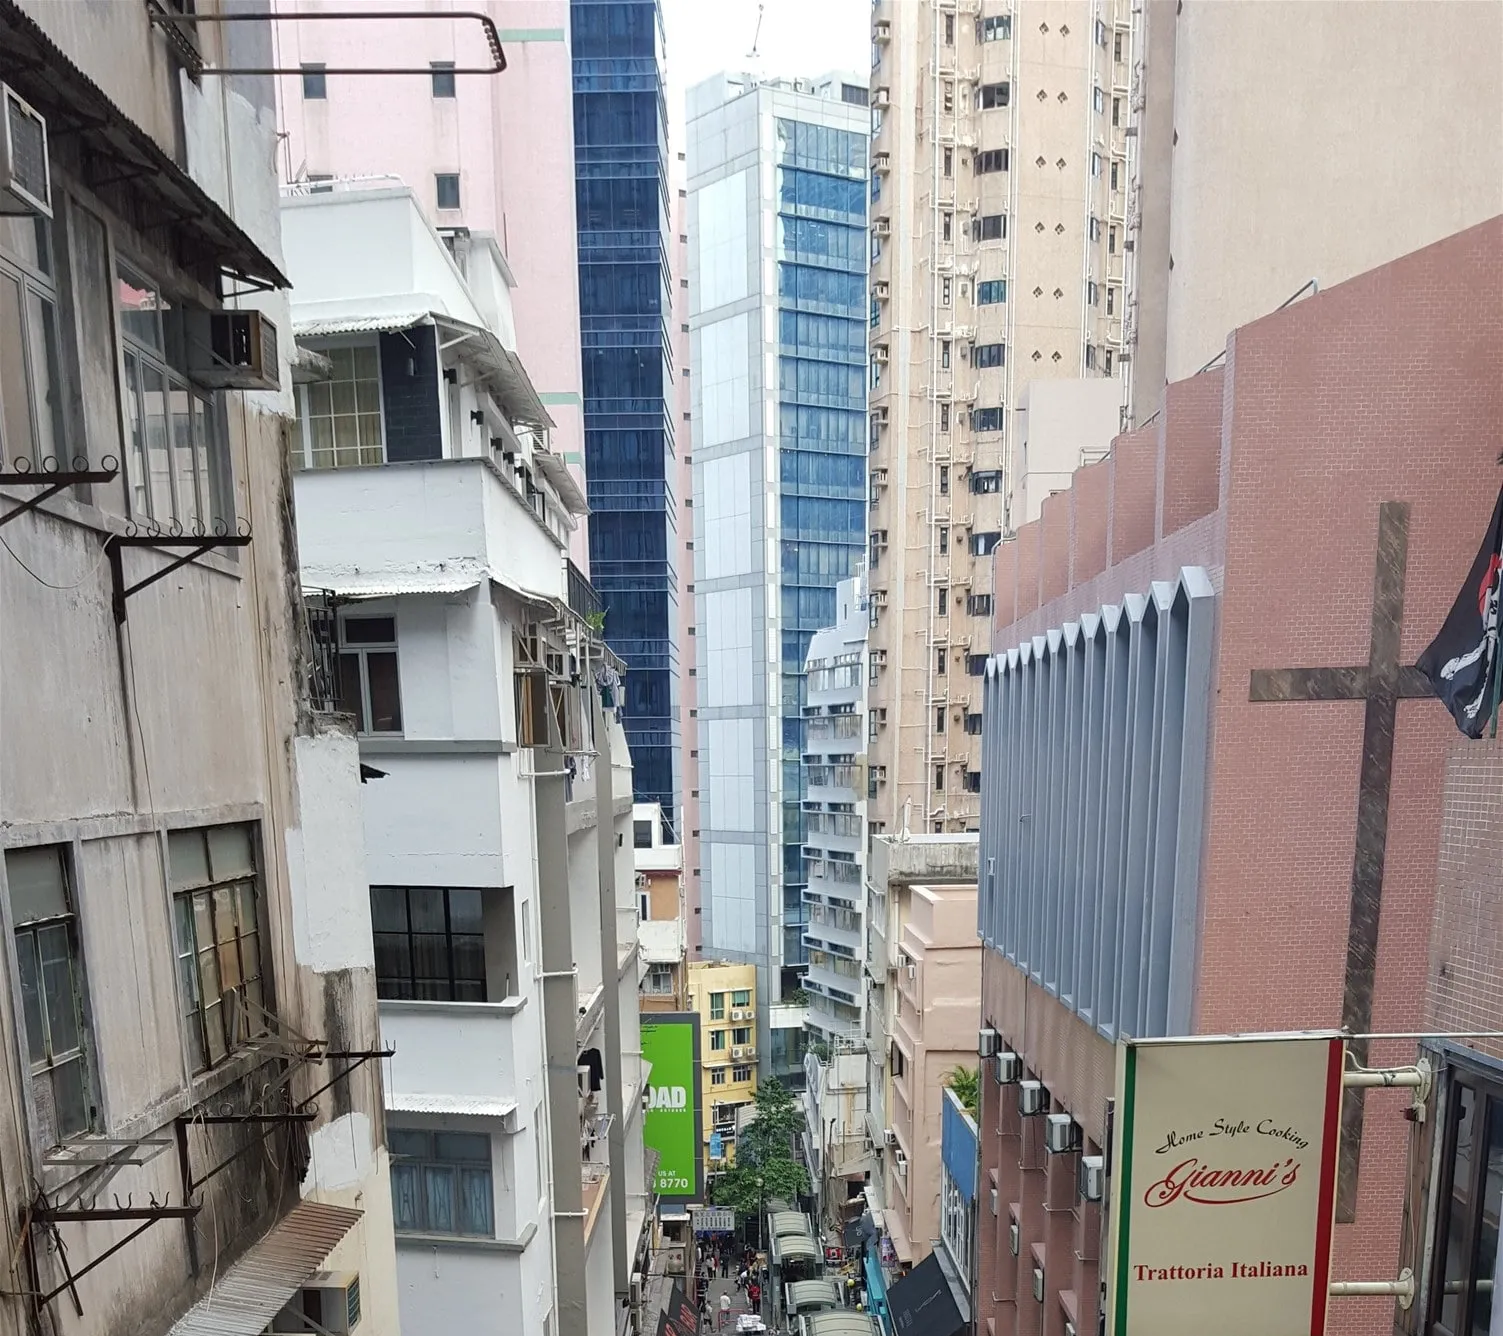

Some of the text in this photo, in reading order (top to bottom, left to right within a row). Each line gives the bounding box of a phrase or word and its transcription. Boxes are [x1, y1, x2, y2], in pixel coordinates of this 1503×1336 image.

[1155, 1118, 1309, 1154] Home Style Cooking
[660, 1178, 689, 1189] 8770
[1144, 1158, 1301, 1208] Gianni's
[1134, 1261, 1309, 1281] Trattoria Italiana
